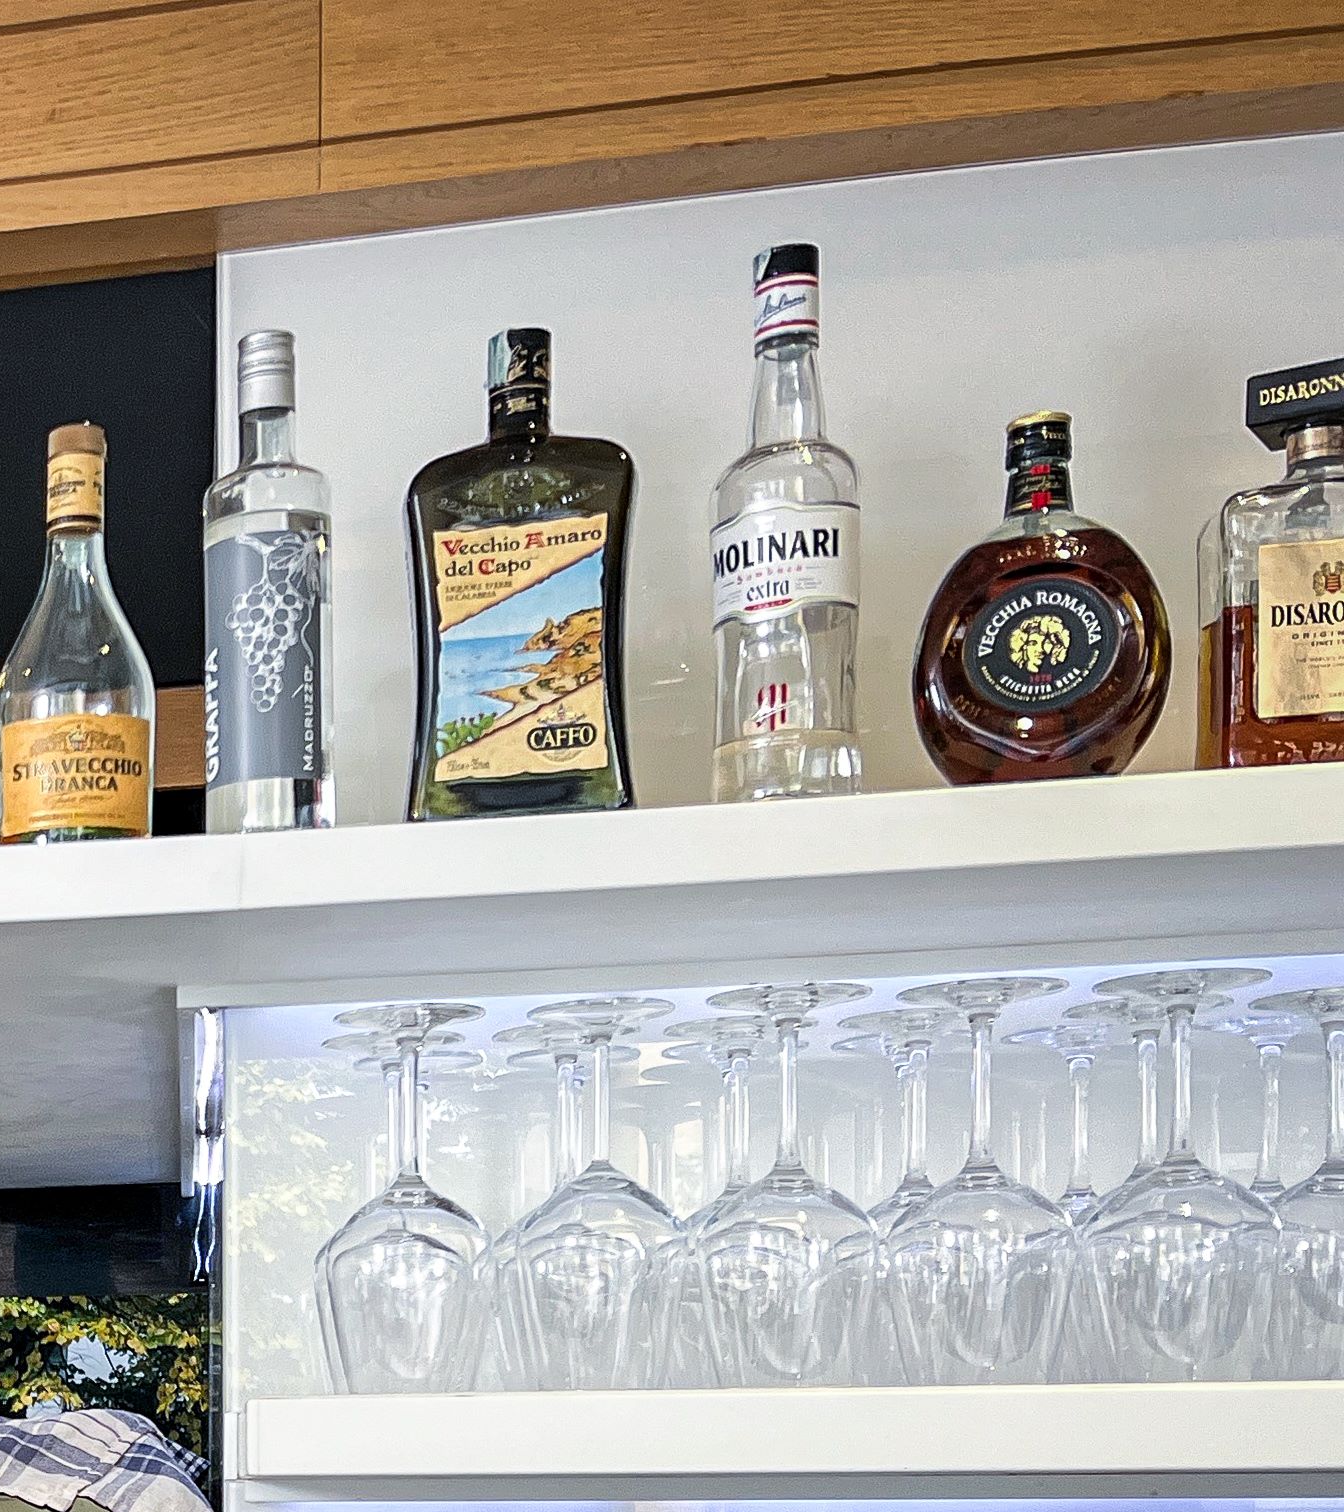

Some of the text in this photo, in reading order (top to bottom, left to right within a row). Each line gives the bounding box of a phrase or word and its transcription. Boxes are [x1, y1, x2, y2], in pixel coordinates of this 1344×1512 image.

[441, 529, 602, 557] Vecchio Amaro
[713, 527, 840, 582] MOLINARI
[445, 557, 531, 578] del Capo
[746, 579, 790, 602] extra
[978, 590, 1102, 658] VECCHIA ROMAGNA
[205, 647, 220, 784] GRAPPA
[529, 726, 594, 748] CAFFO
[12, 757, 142, 782] STRAVECCHIO
